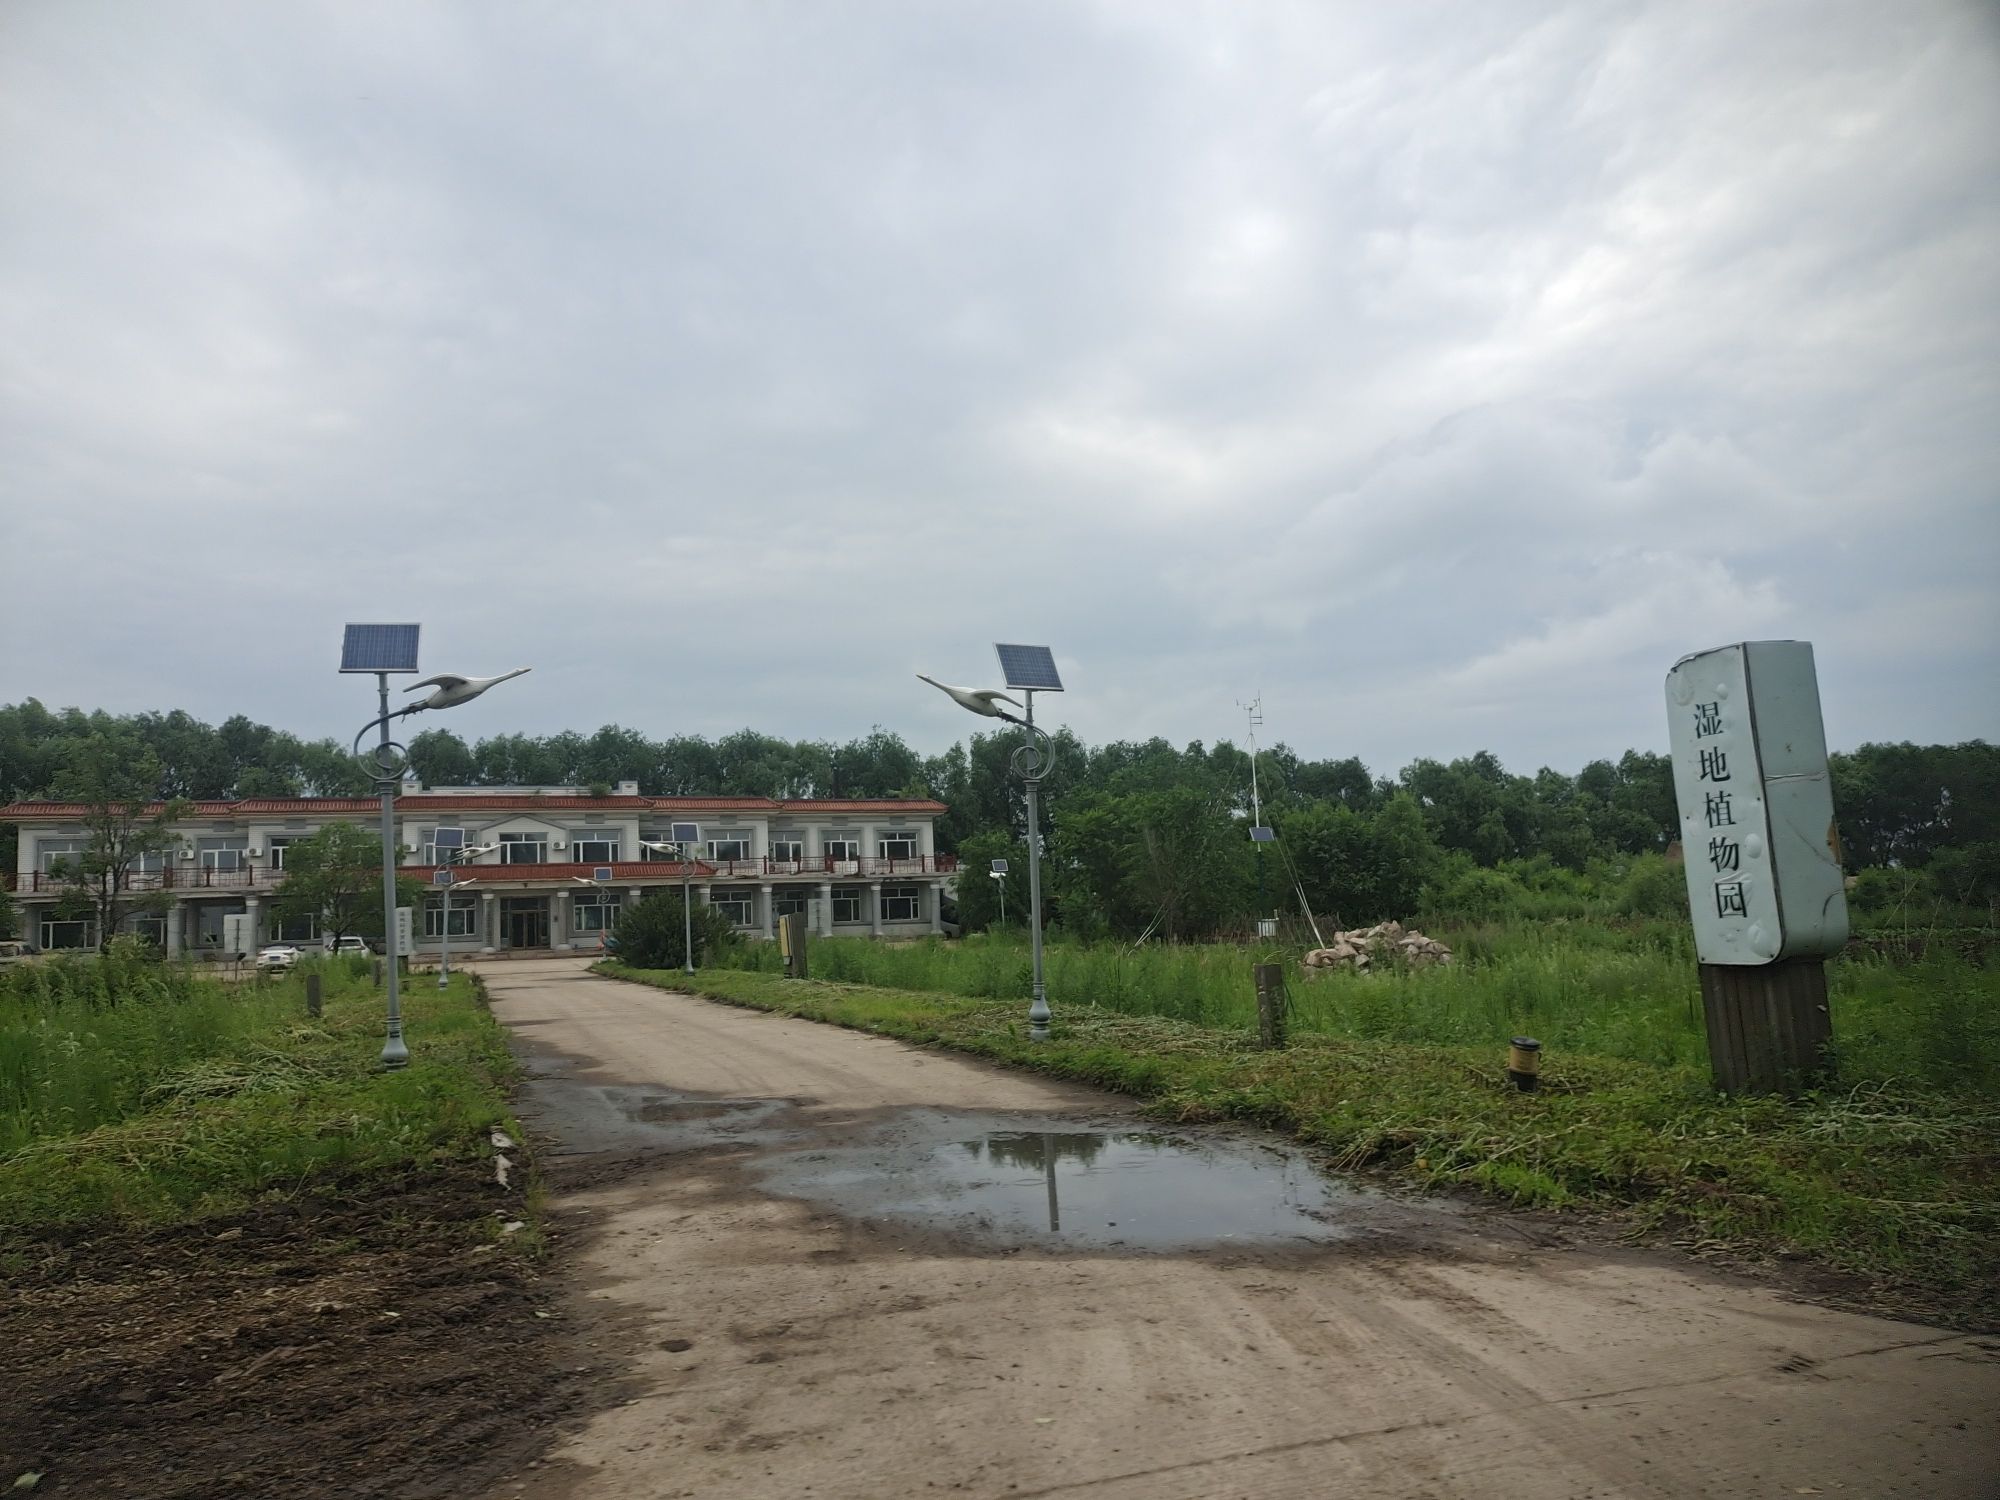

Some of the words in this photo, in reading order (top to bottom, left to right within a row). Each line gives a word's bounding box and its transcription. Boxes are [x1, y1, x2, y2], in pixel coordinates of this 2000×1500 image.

[1693, 701, 1748, 919] 湿地植物园
